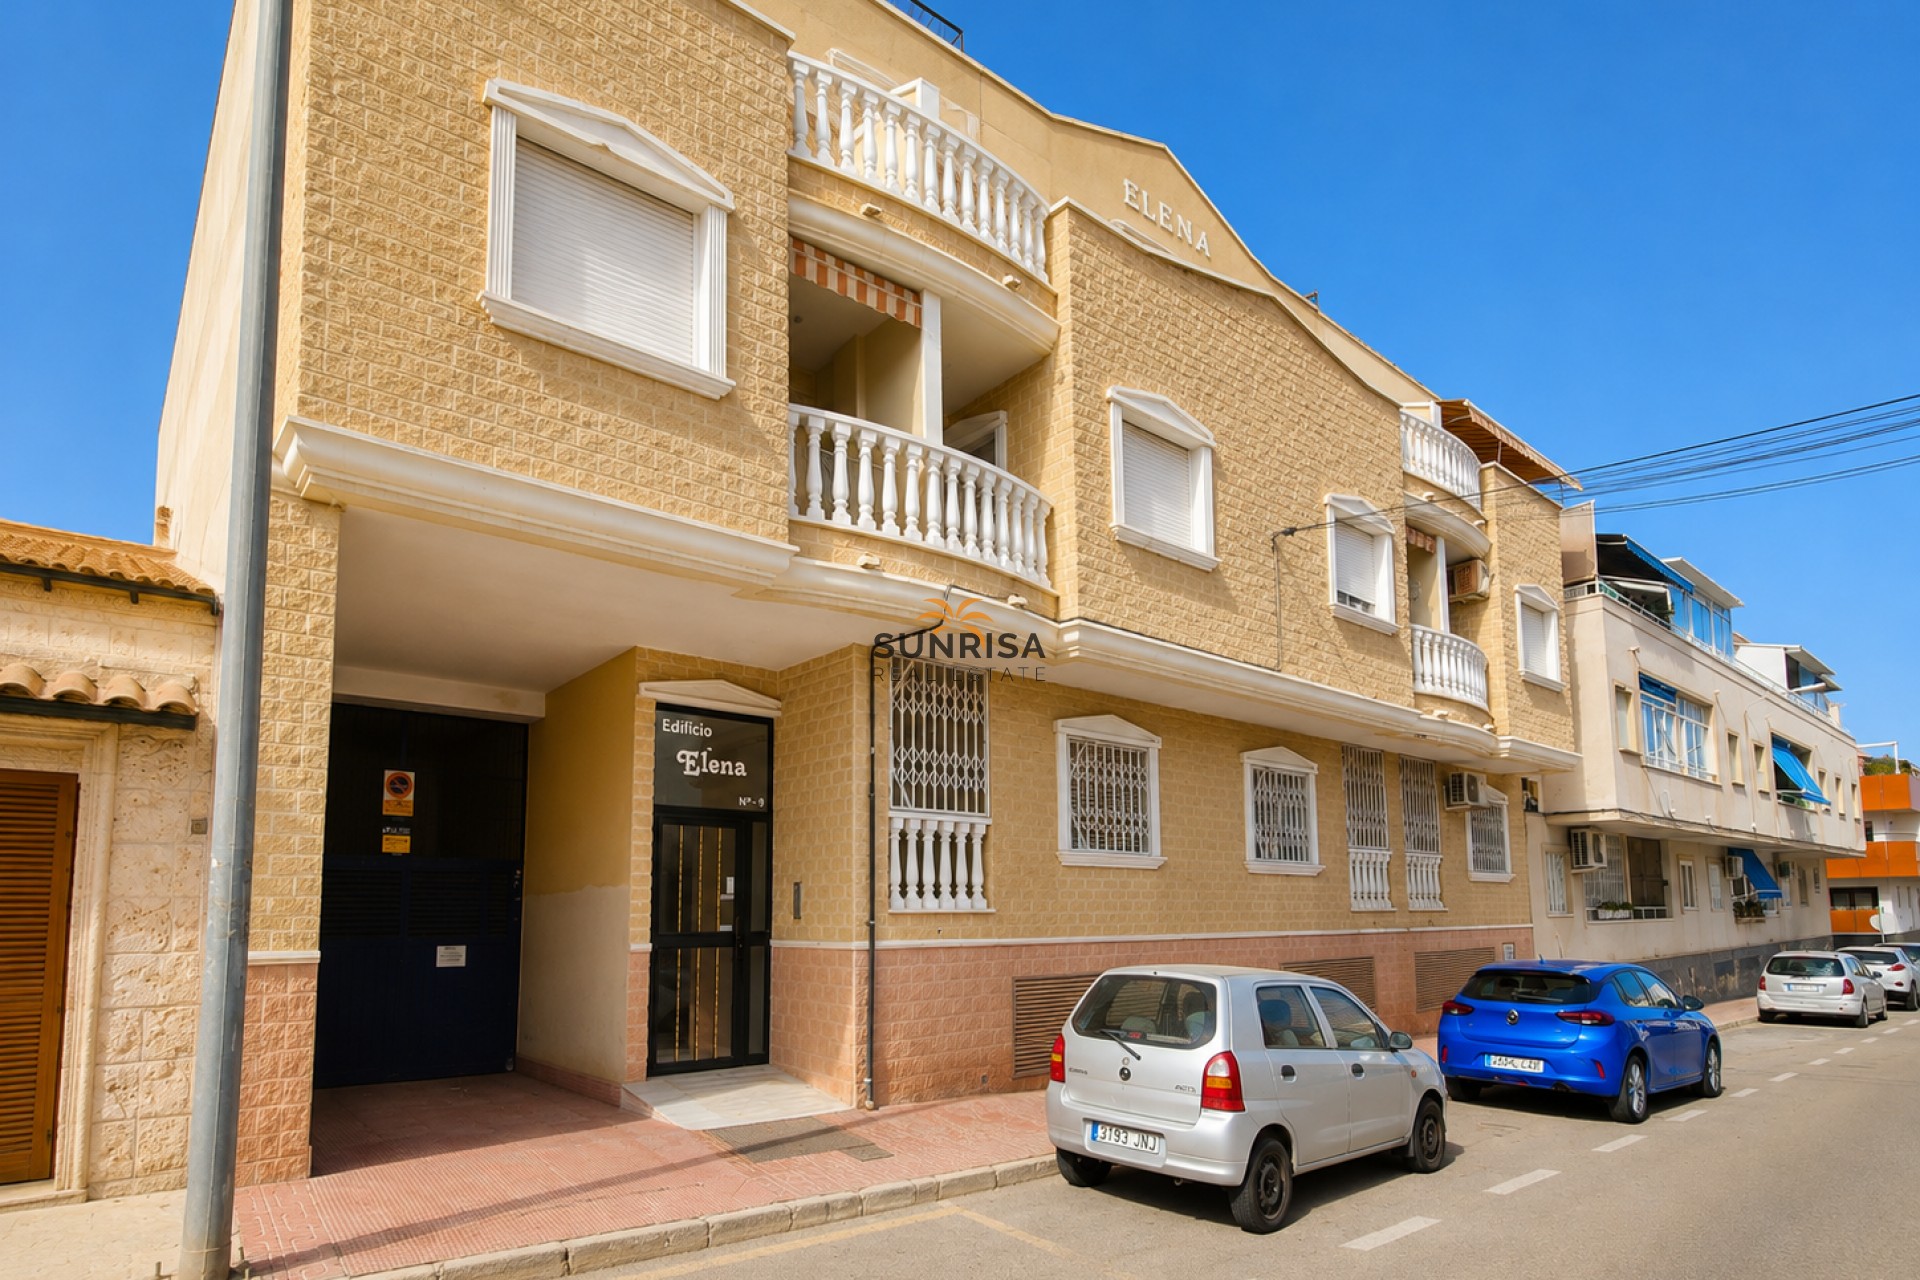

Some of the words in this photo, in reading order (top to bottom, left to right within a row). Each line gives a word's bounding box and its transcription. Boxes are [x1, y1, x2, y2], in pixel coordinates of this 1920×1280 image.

[1123, 178, 1211, 258] ELENA
[662, 718, 713, 737] Edificio
[1099, 1125, 1128, 1145] 3193
[1133, 1133, 1157, 1151] JNJ
